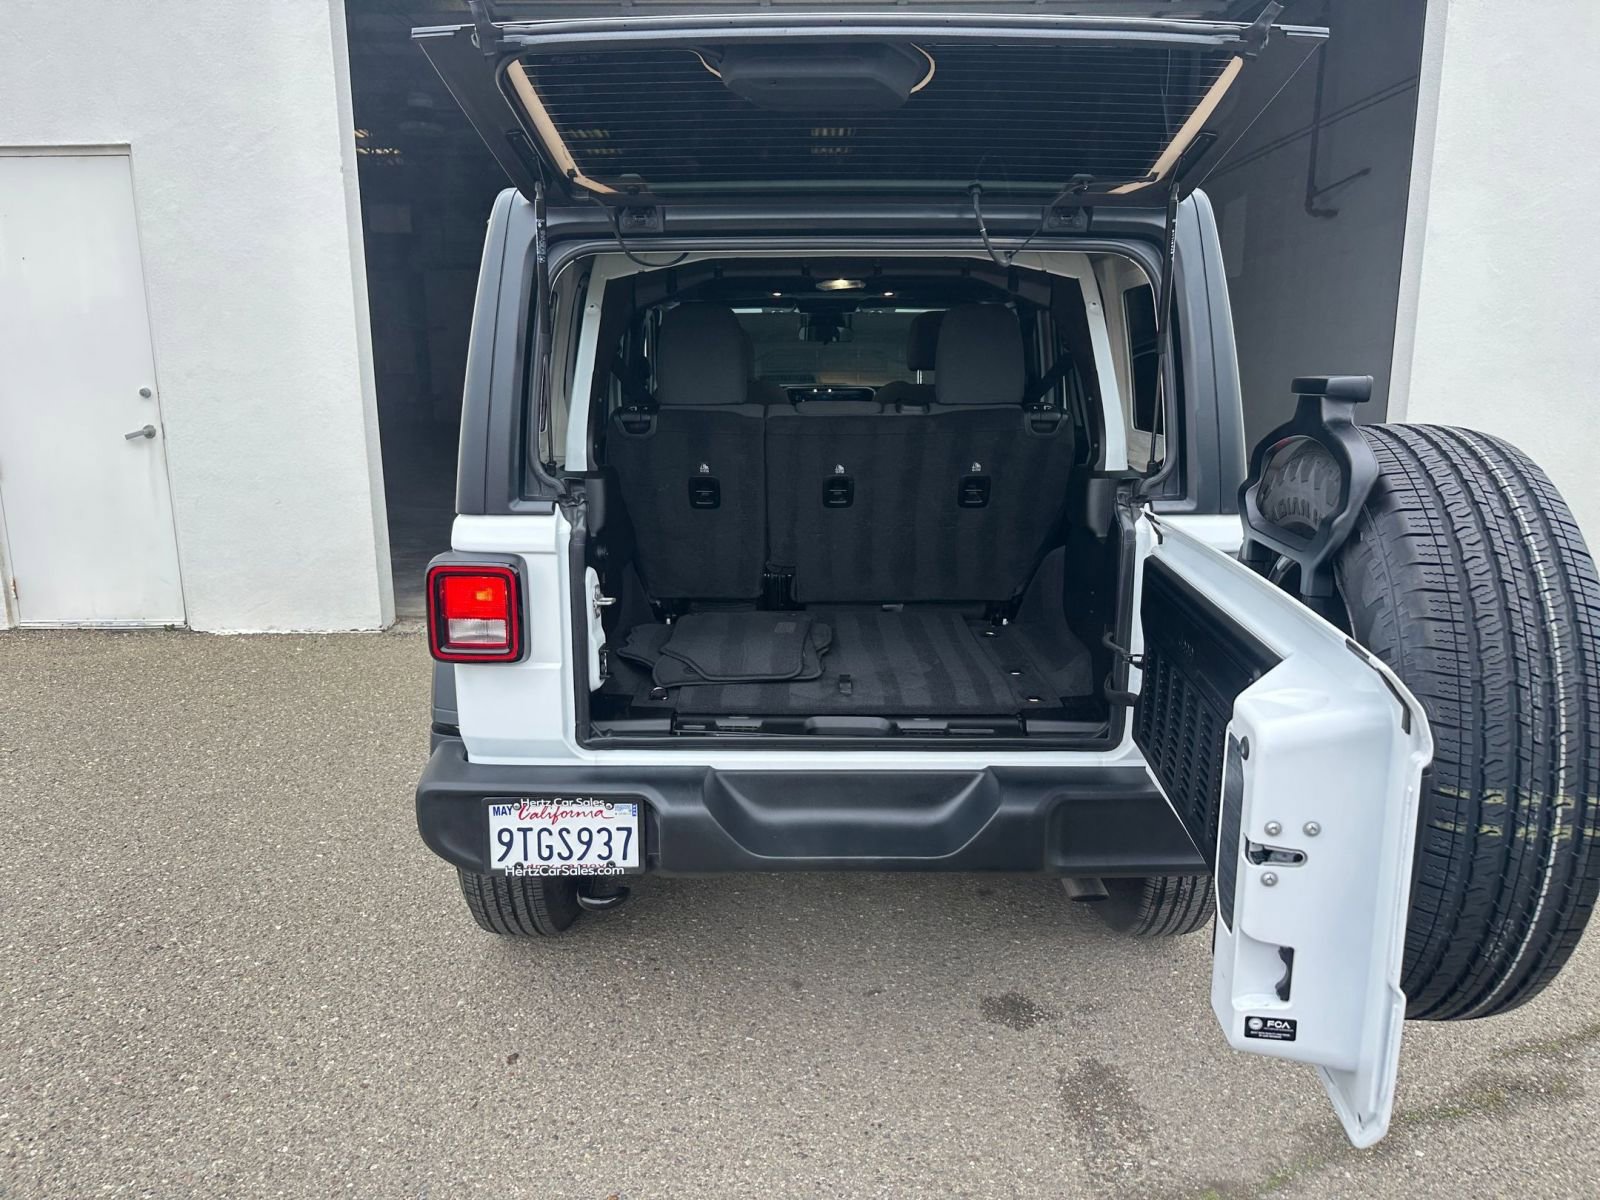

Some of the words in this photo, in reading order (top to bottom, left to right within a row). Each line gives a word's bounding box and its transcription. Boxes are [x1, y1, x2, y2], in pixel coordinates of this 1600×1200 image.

[520, 798, 550, 807] Hertz
[554, 798, 575, 807] Car
[578, 797, 606, 807] Sales
[493, 806, 513, 817] MAY
[518, 803, 615, 825] California
[497, 827, 633, 862] 9TGS937
[505, 866, 625, 877] HertzCarSales.com
[1267, 1020, 1291, 1029] FCA
